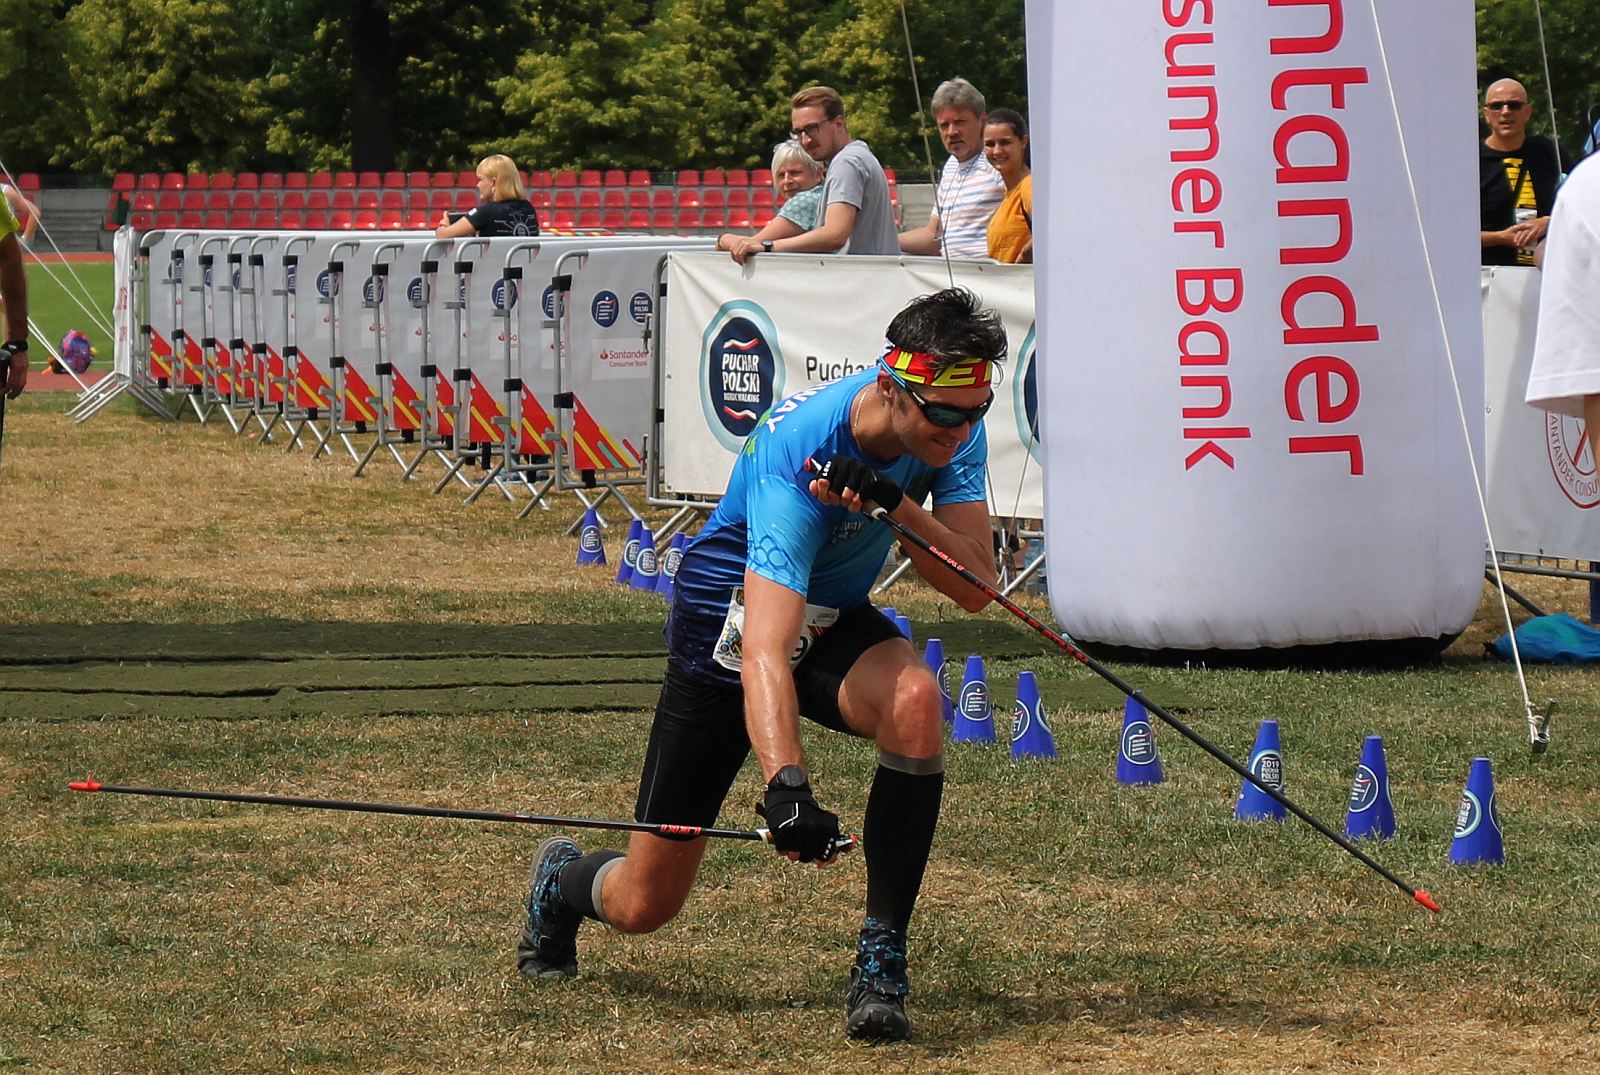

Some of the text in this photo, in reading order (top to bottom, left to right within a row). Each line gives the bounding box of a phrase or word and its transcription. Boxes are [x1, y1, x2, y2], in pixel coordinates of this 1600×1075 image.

[1162, 0, 1252, 471] sumer Bank
[1268, 0, 1379, 476] ntander
[722, 353, 760, 371] PUCHAR
[722, 372, 760, 393] POLSKI
[806, 356, 875, 382] Puch
[1550, 411, 1575, 488] ANTANDER
